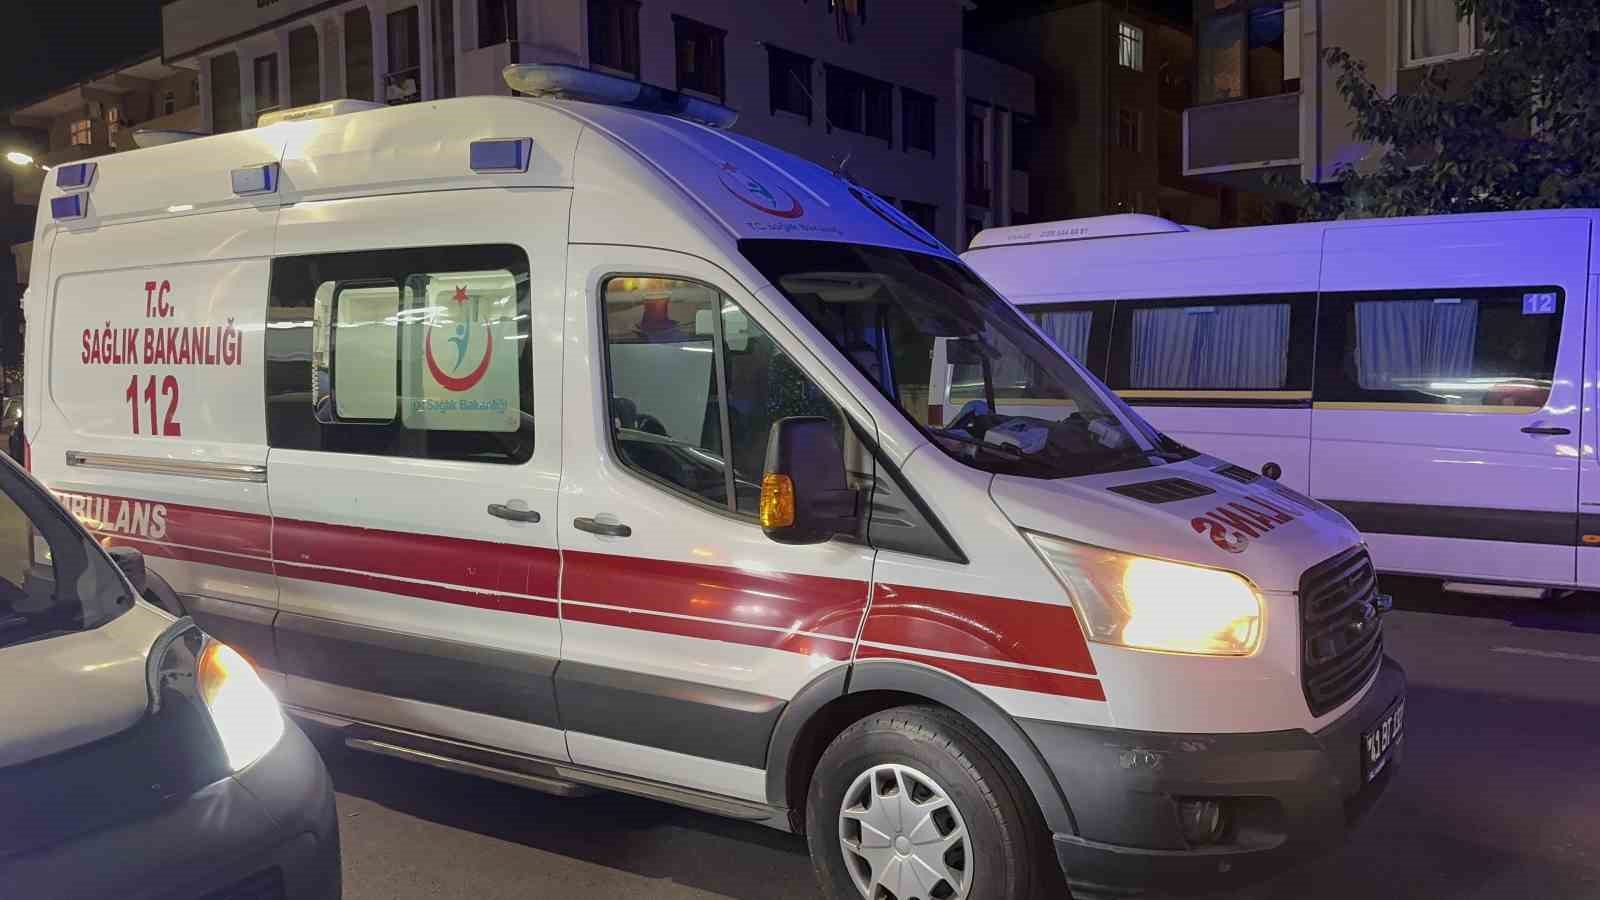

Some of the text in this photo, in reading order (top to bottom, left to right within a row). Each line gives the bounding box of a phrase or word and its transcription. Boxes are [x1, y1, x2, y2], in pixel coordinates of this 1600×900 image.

[144, 279, 175, 318] T.C.
[1526, 293, 1552, 312] 12
[81, 317, 243, 366] SAĞLIK BAKANLIĞI
[126, 374, 182, 437] 112
